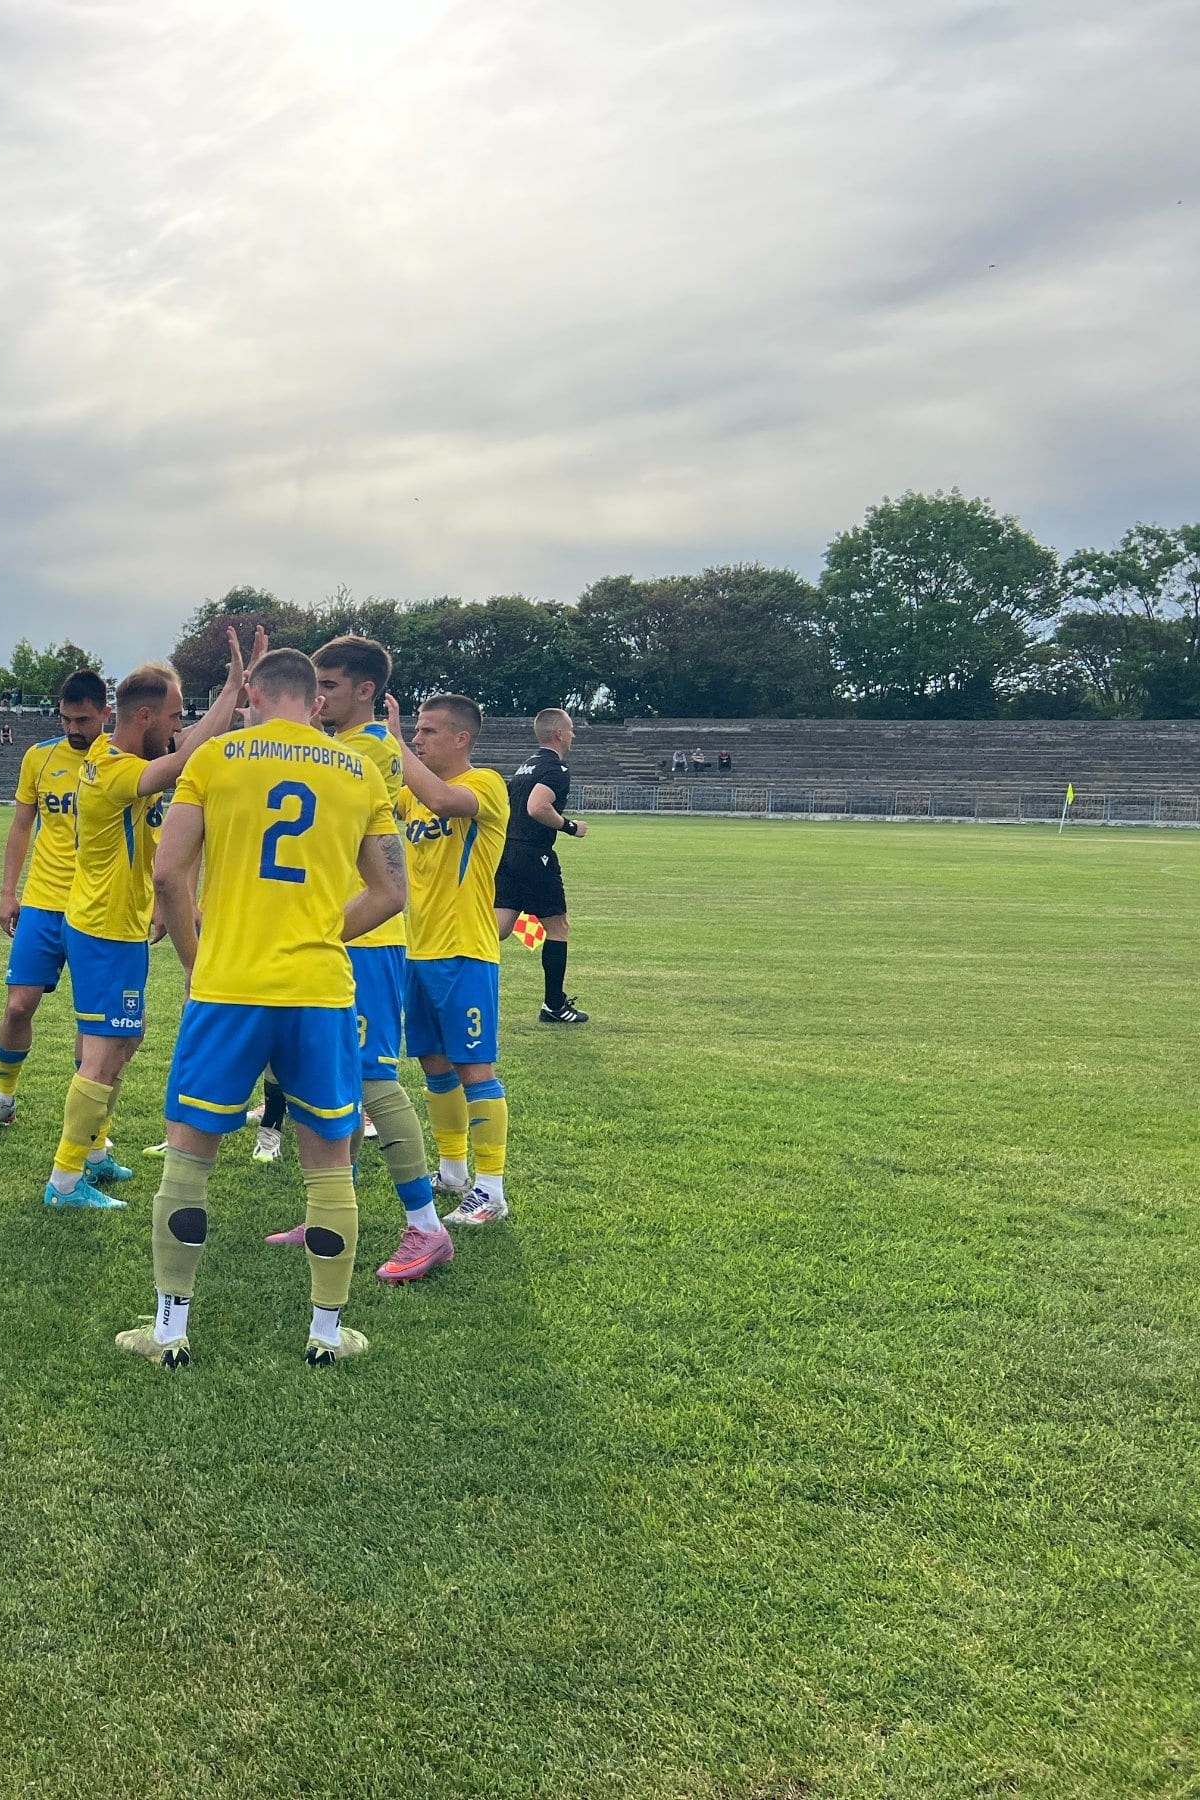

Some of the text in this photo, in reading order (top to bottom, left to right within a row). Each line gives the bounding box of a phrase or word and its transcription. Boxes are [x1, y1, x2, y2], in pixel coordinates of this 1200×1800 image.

[224, 739, 364, 780] ФК ДИМИТРОВГРАД
[259, 780, 317, 883] 2
[110, 1017, 142, 1028] efbe
[466, 1007, 482, 1037] 3
